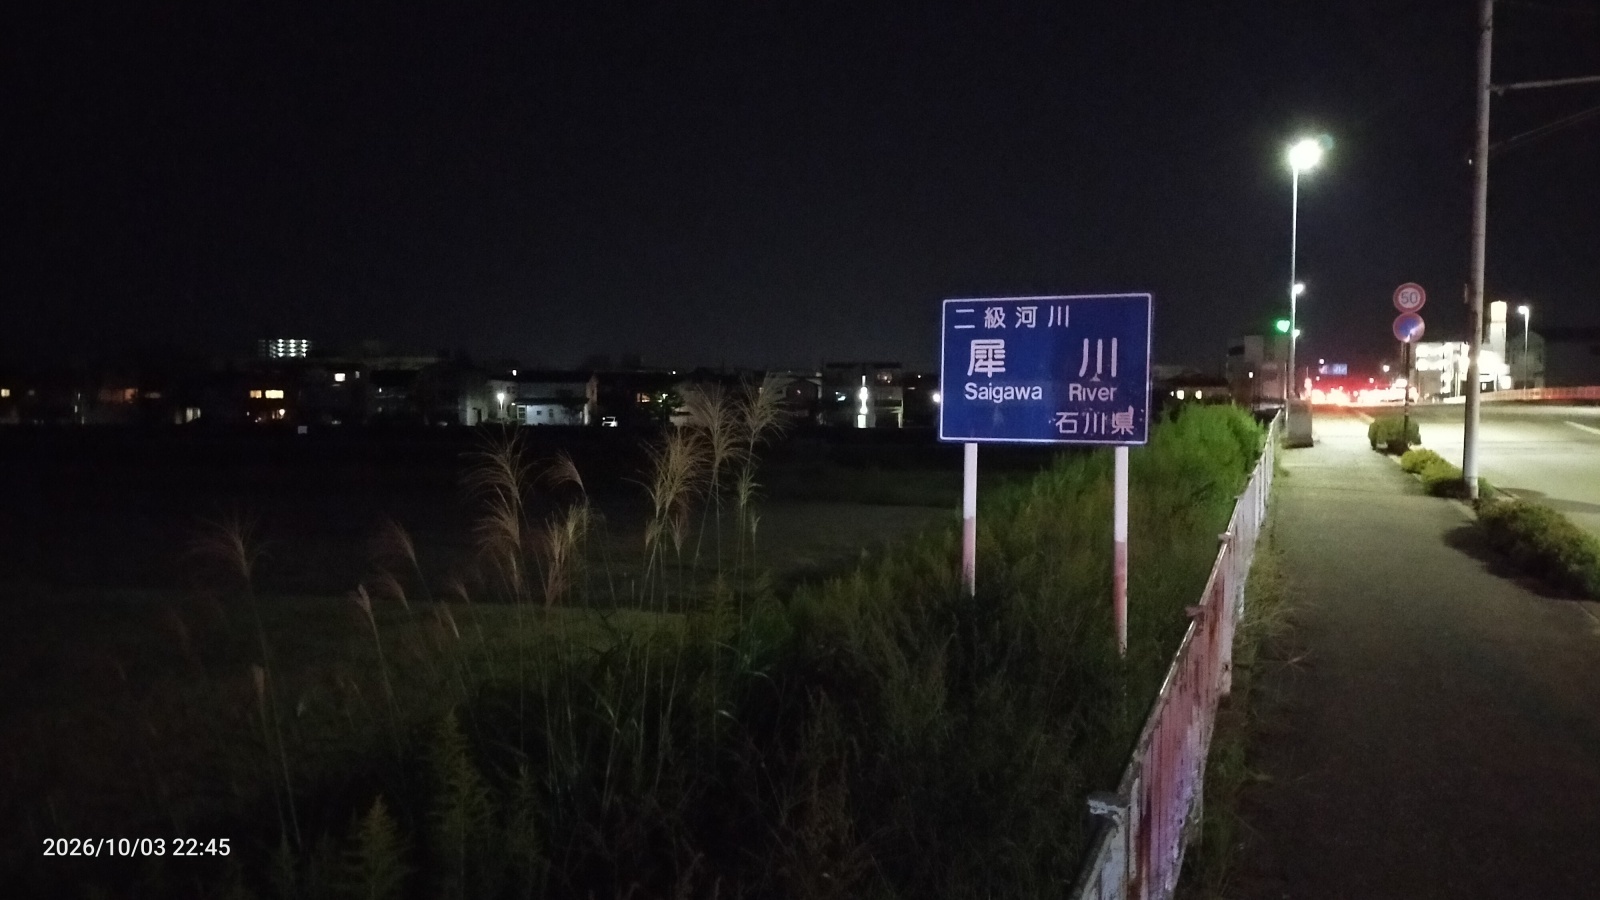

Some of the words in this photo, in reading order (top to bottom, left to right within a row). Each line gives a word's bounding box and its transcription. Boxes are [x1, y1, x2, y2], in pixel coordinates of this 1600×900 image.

[1401, 291, 1418, 304] 50
[953, 305, 1070, 329] 二級河川
[964, 382, 1043, 403] Saigawa
[1068, 383, 1117, 402] River
[1055, 411, 1134, 435] 石川県
